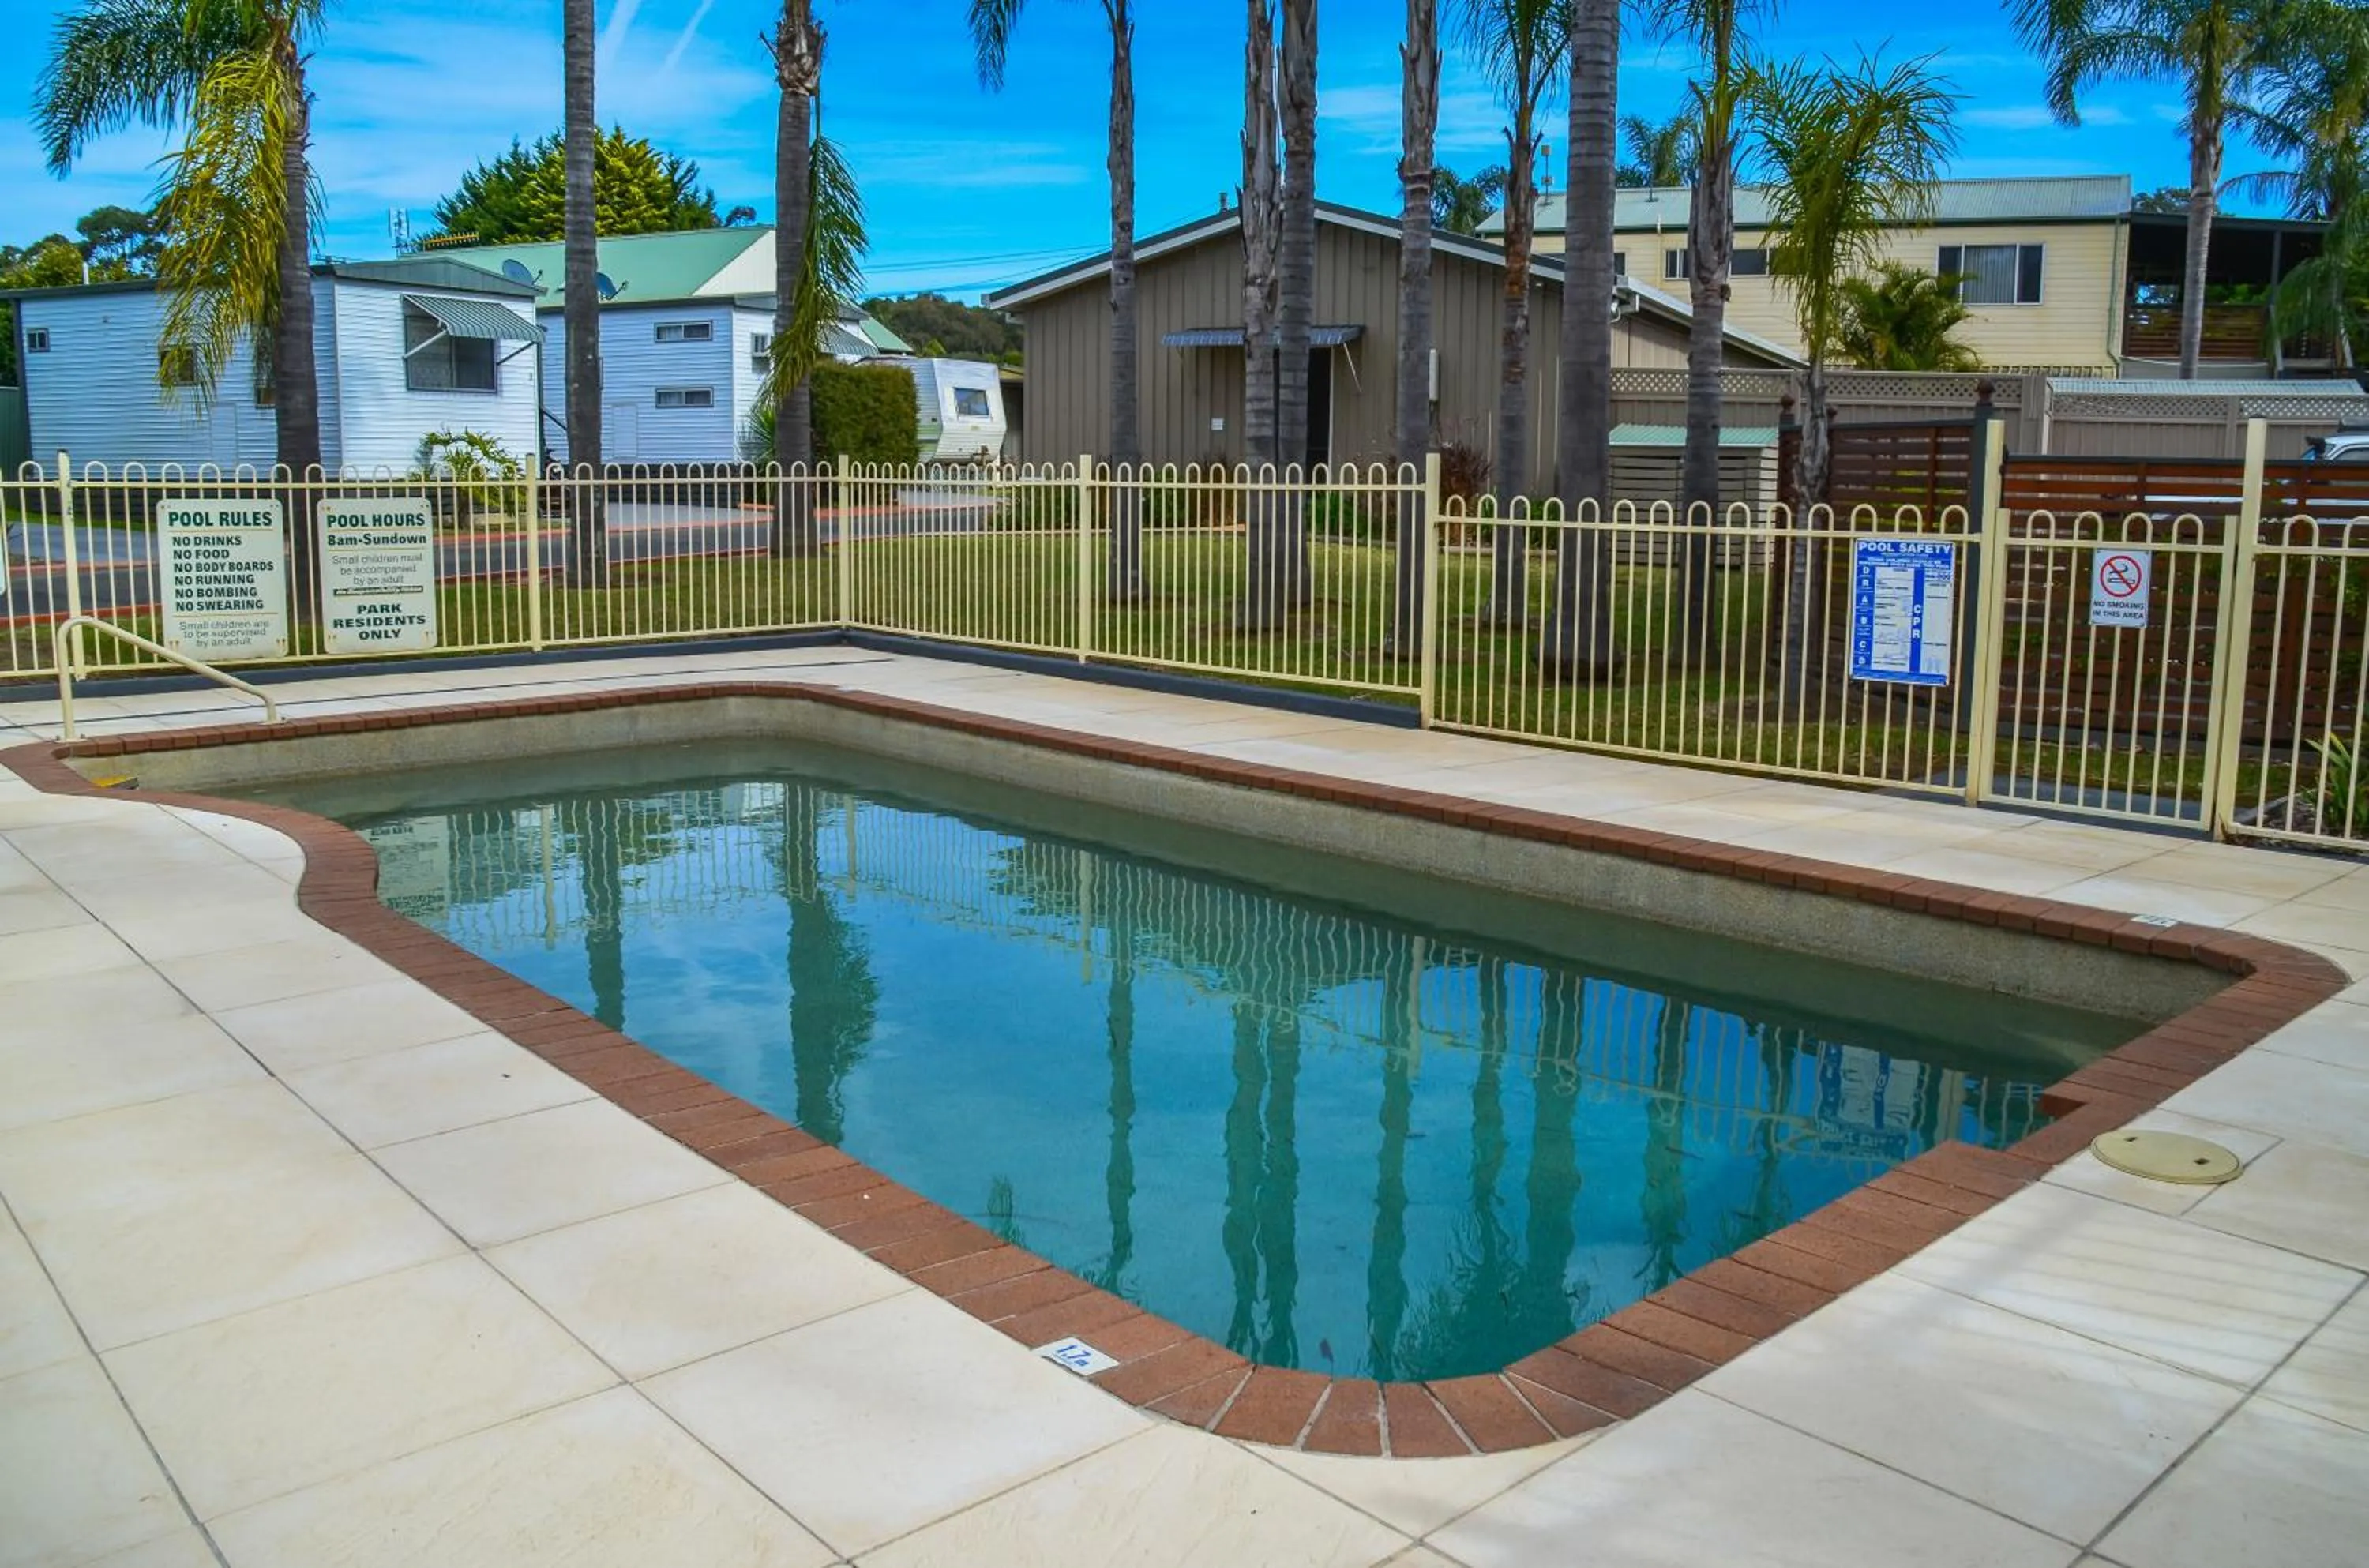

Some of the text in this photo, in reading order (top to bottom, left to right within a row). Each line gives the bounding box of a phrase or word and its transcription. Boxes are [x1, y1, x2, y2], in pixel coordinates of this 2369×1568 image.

[168, 512, 272, 527] POOL RULES
[327, 513, 425, 527] POOL HOURS
[172, 536, 242, 546] NO DRINKS
[328, 533, 426, 546] 8am-Sundown
[1859, 542, 1950, 553] POOL SAFETY
[173, 549, 230, 560] NO FOOD
[332, 555, 359, 564] Small
[174, 561, 275, 572] NO BODY BOARDS
[175, 575, 255, 585] NO RUNNING
[175, 587, 257, 598] NO BOMBING
[176, 600, 264, 612] NO SWEARING
[357, 603, 402, 614] PARK
[2107, 601, 2144, 610] SMOKING
[179, 621, 209, 631] Small
[211, 621, 251, 630] children
[333, 615, 426, 628] RESIDENTS
[359, 629, 401, 640] ONLY
